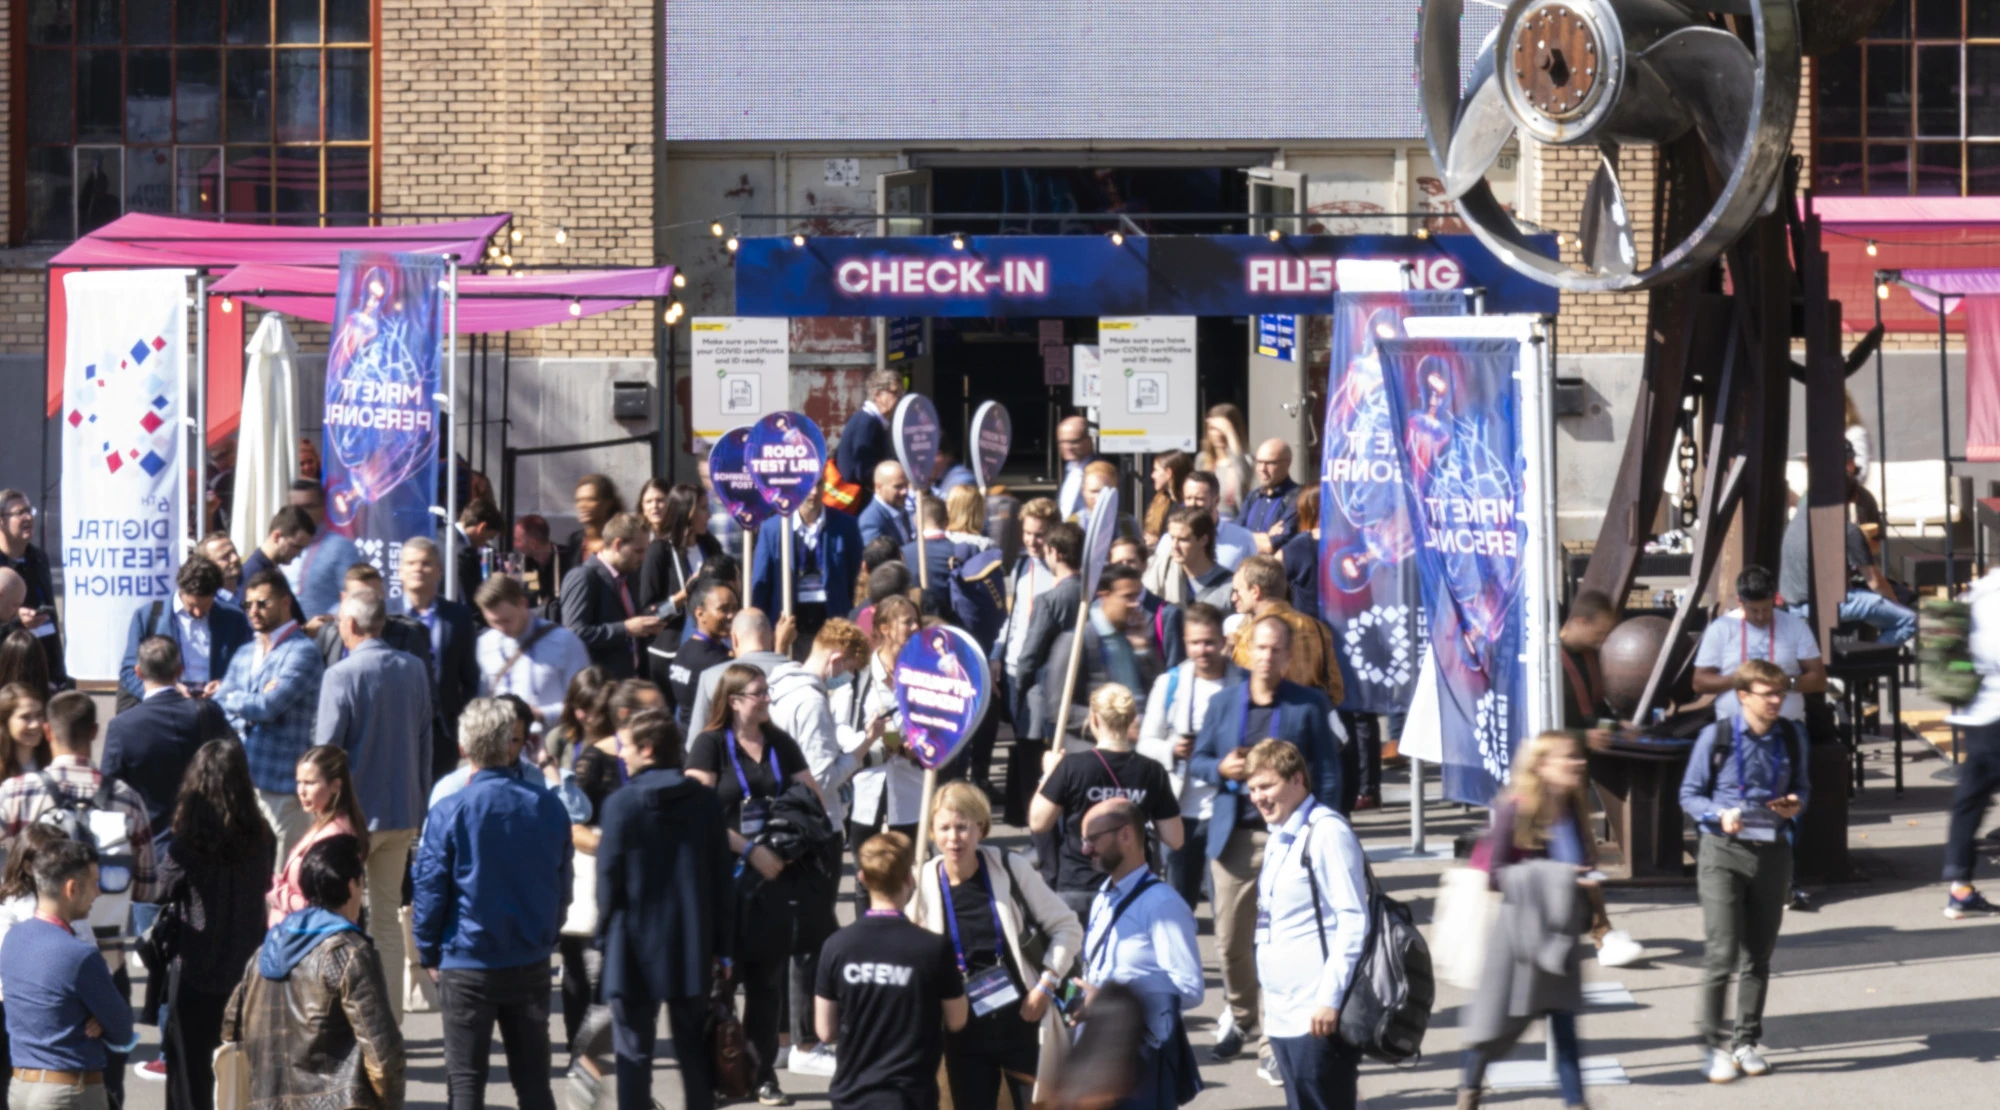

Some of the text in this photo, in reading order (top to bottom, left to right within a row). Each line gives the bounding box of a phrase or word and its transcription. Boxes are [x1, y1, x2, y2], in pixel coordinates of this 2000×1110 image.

[838, 260, 1045, 293] CHECK-IN
[1249, 258, 1461, 291] AUSNG
[743, 339, 758, 347] you
[759, 337, 779, 345] have
[1151, 338, 1165, 346] you
[696, 347, 785, 356] your COVID certificate
[1103, 346, 1192, 355] your COVID certificate
[714, 357, 730, 365] and
[731, 357, 740, 365] ID
[1121, 356, 1138, 364] and
[762, 444, 808, 459] ROBO
[750, 459, 787, 473] TEST
[789, 459, 820, 473] LAB
[730, 481, 754, 490] POST
[842, 961, 914, 987] CREW
